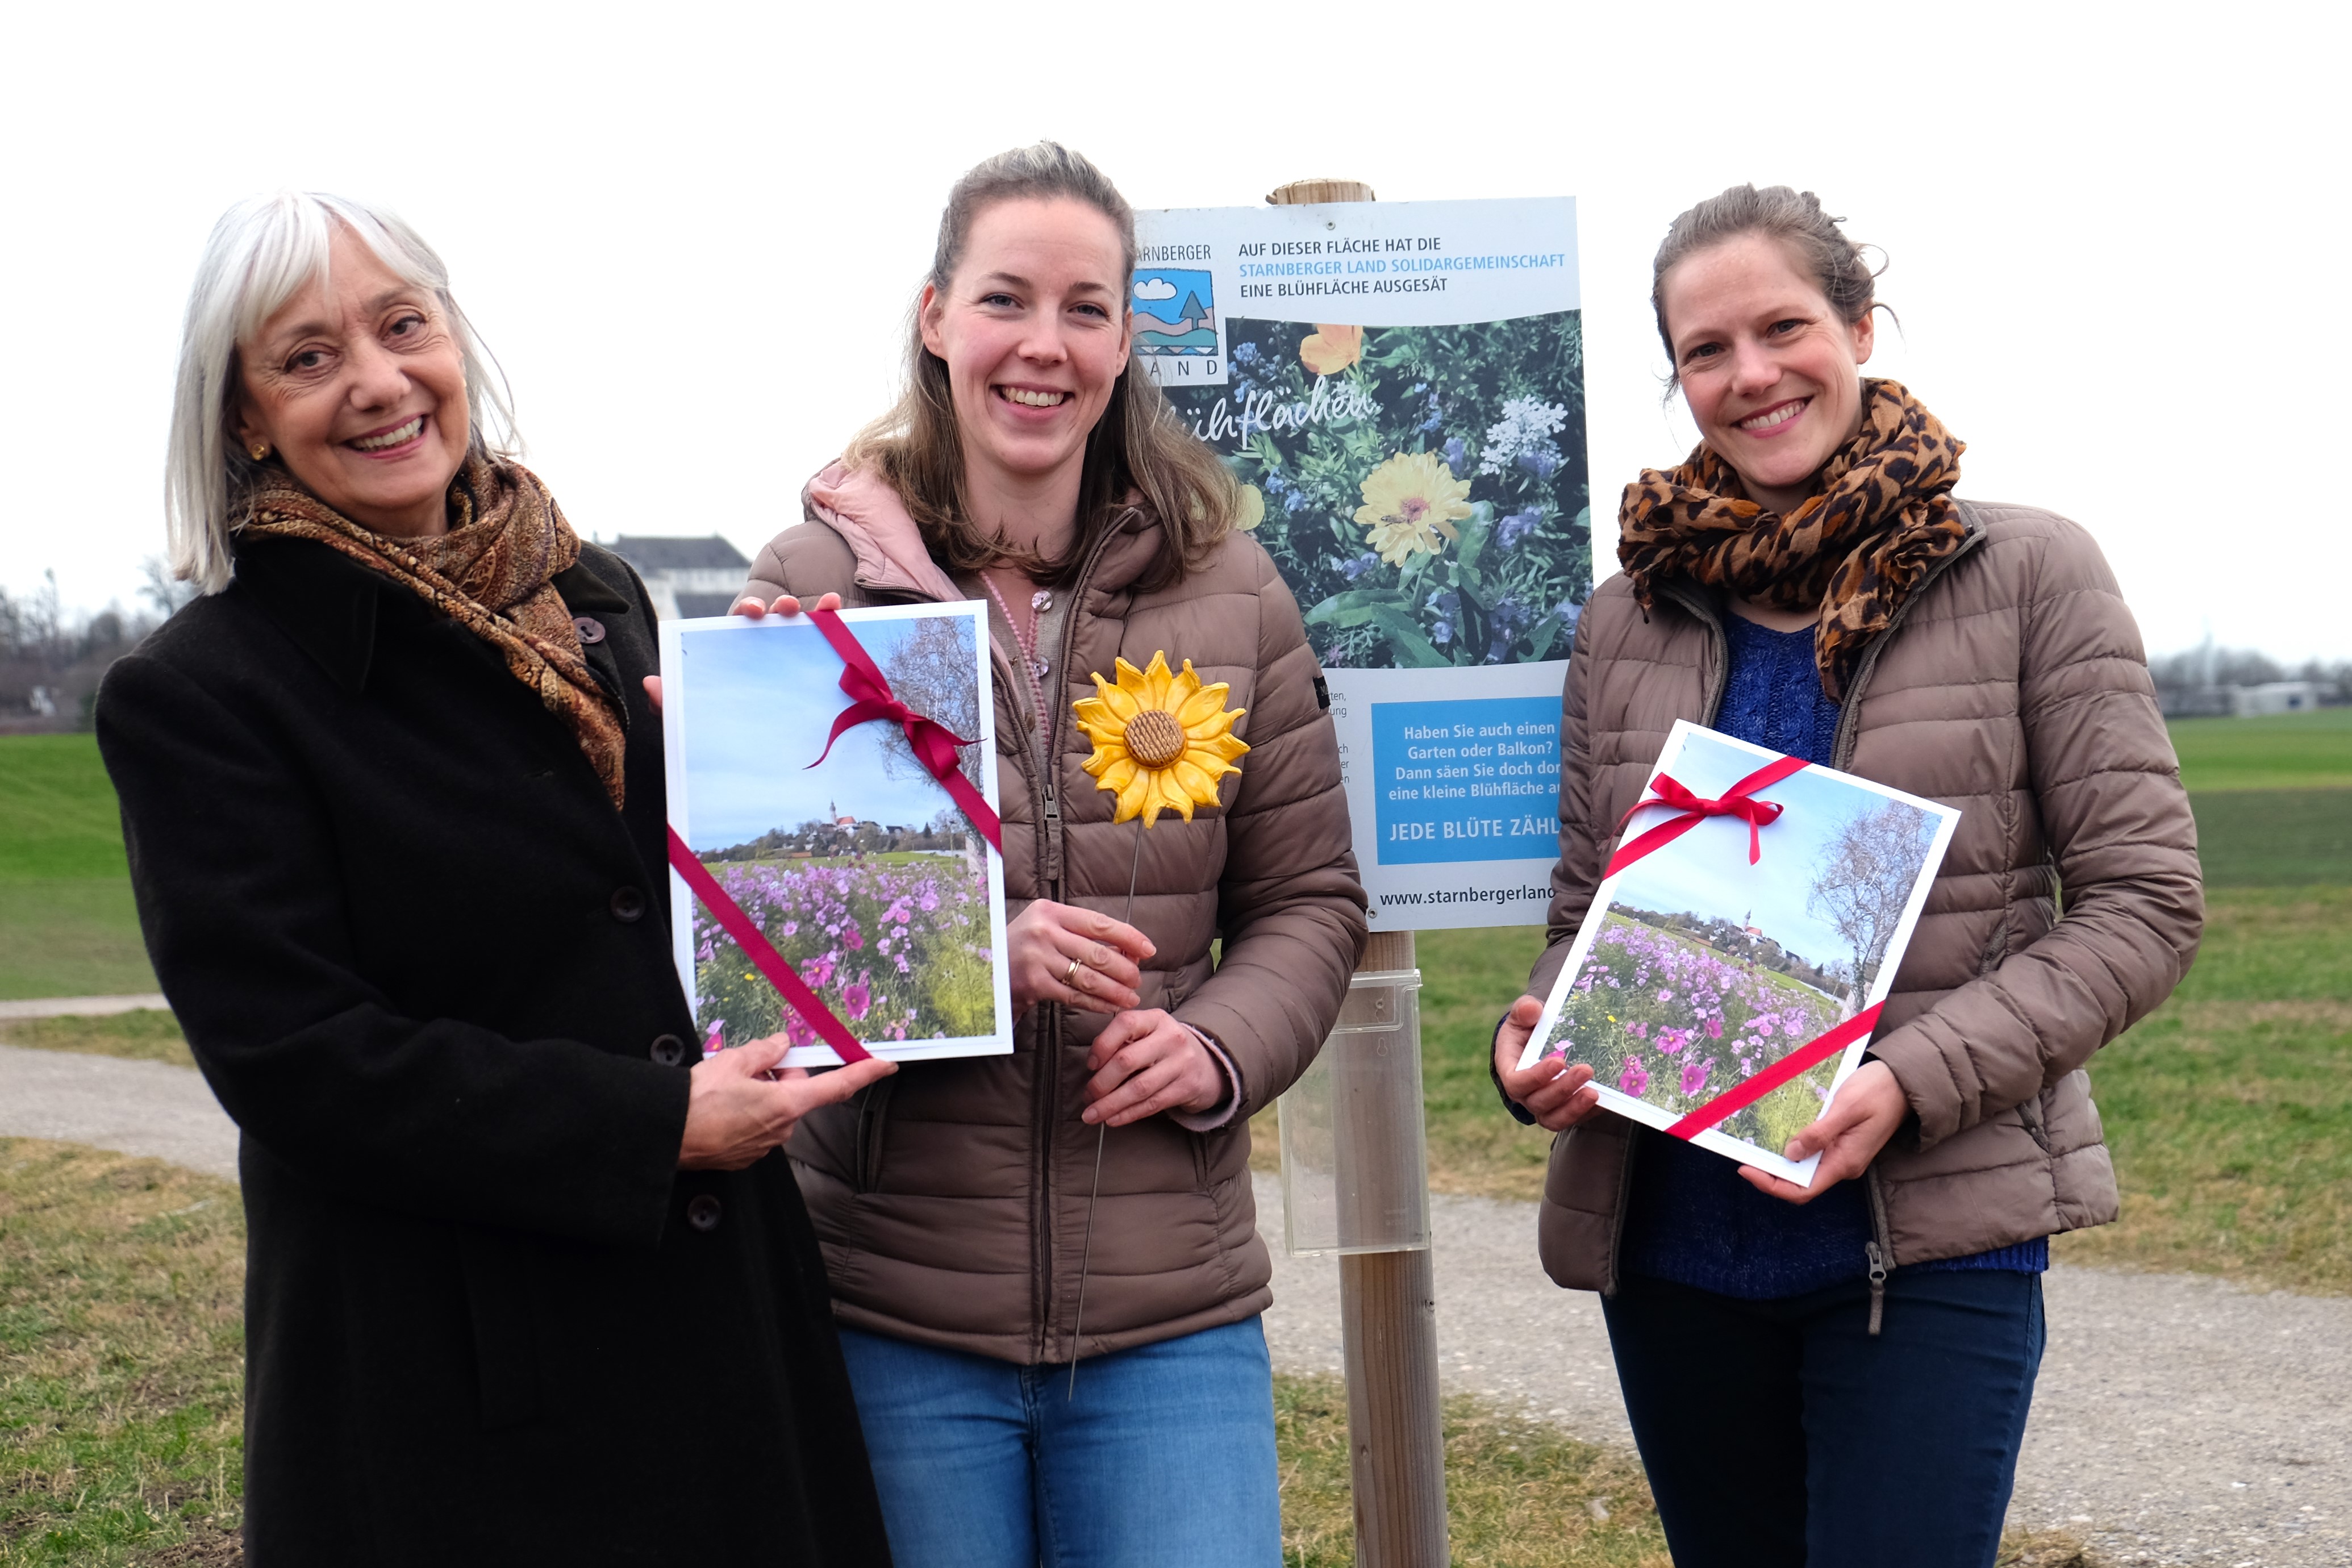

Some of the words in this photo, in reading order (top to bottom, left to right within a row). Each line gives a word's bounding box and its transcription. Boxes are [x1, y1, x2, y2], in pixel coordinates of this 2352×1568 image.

[1136, 244, 1211, 261] ARNBERGER
[1238, 243, 1266, 256] AUF
[1272, 241, 1321, 255] DIESER
[1327, 237, 1380, 253] FLÄCHE
[1386, 239, 1412, 252] HAT
[1418, 237, 1441, 251] DIE
[1239, 261, 1342, 277] STARNBERGER
[1348, 260, 1386, 274] LAND
[1392, 254, 1565, 272] SOLIDARGEMEINSCHAFT
[1240, 284, 1273, 297] EINE
[1278, 279, 1369, 296] BLÜHFLÄCHE
[1373, 276, 1448, 293] AUSGESÄT
[1404, 725, 1448, 739] Haben
[1454, 724, 1474, 737] Sie
[1479, 722, 1512, 737] auch
[1517, 722, 1555, 735] einen
[1408, 747, 1456, 759] Garten
[1461, 743, 1492, 757] oder
[1498, 741, 1553, 756] Balkon?
[1396, 767, 1432, 780] Dann
[1436, 765, 1469, 778] säen
[1474, 764, 1494, 777] Sie
[1499, 761, 1532, 775] doch
[1538, 761, 1561, 774] dor
[1389, 787, 1419, 800] eine
[1423, 785, 1466, 799] kleine
[1471, 781, 1544, 796] Blühfläche
[1390, 822, 1436, 841] JEDE
[1443, 816, 1503, 839] BLÜTE
[1510, 814, 1559, 836] ZÄHL
[1380, 885, 1556, 905] www.starnbergerlan
